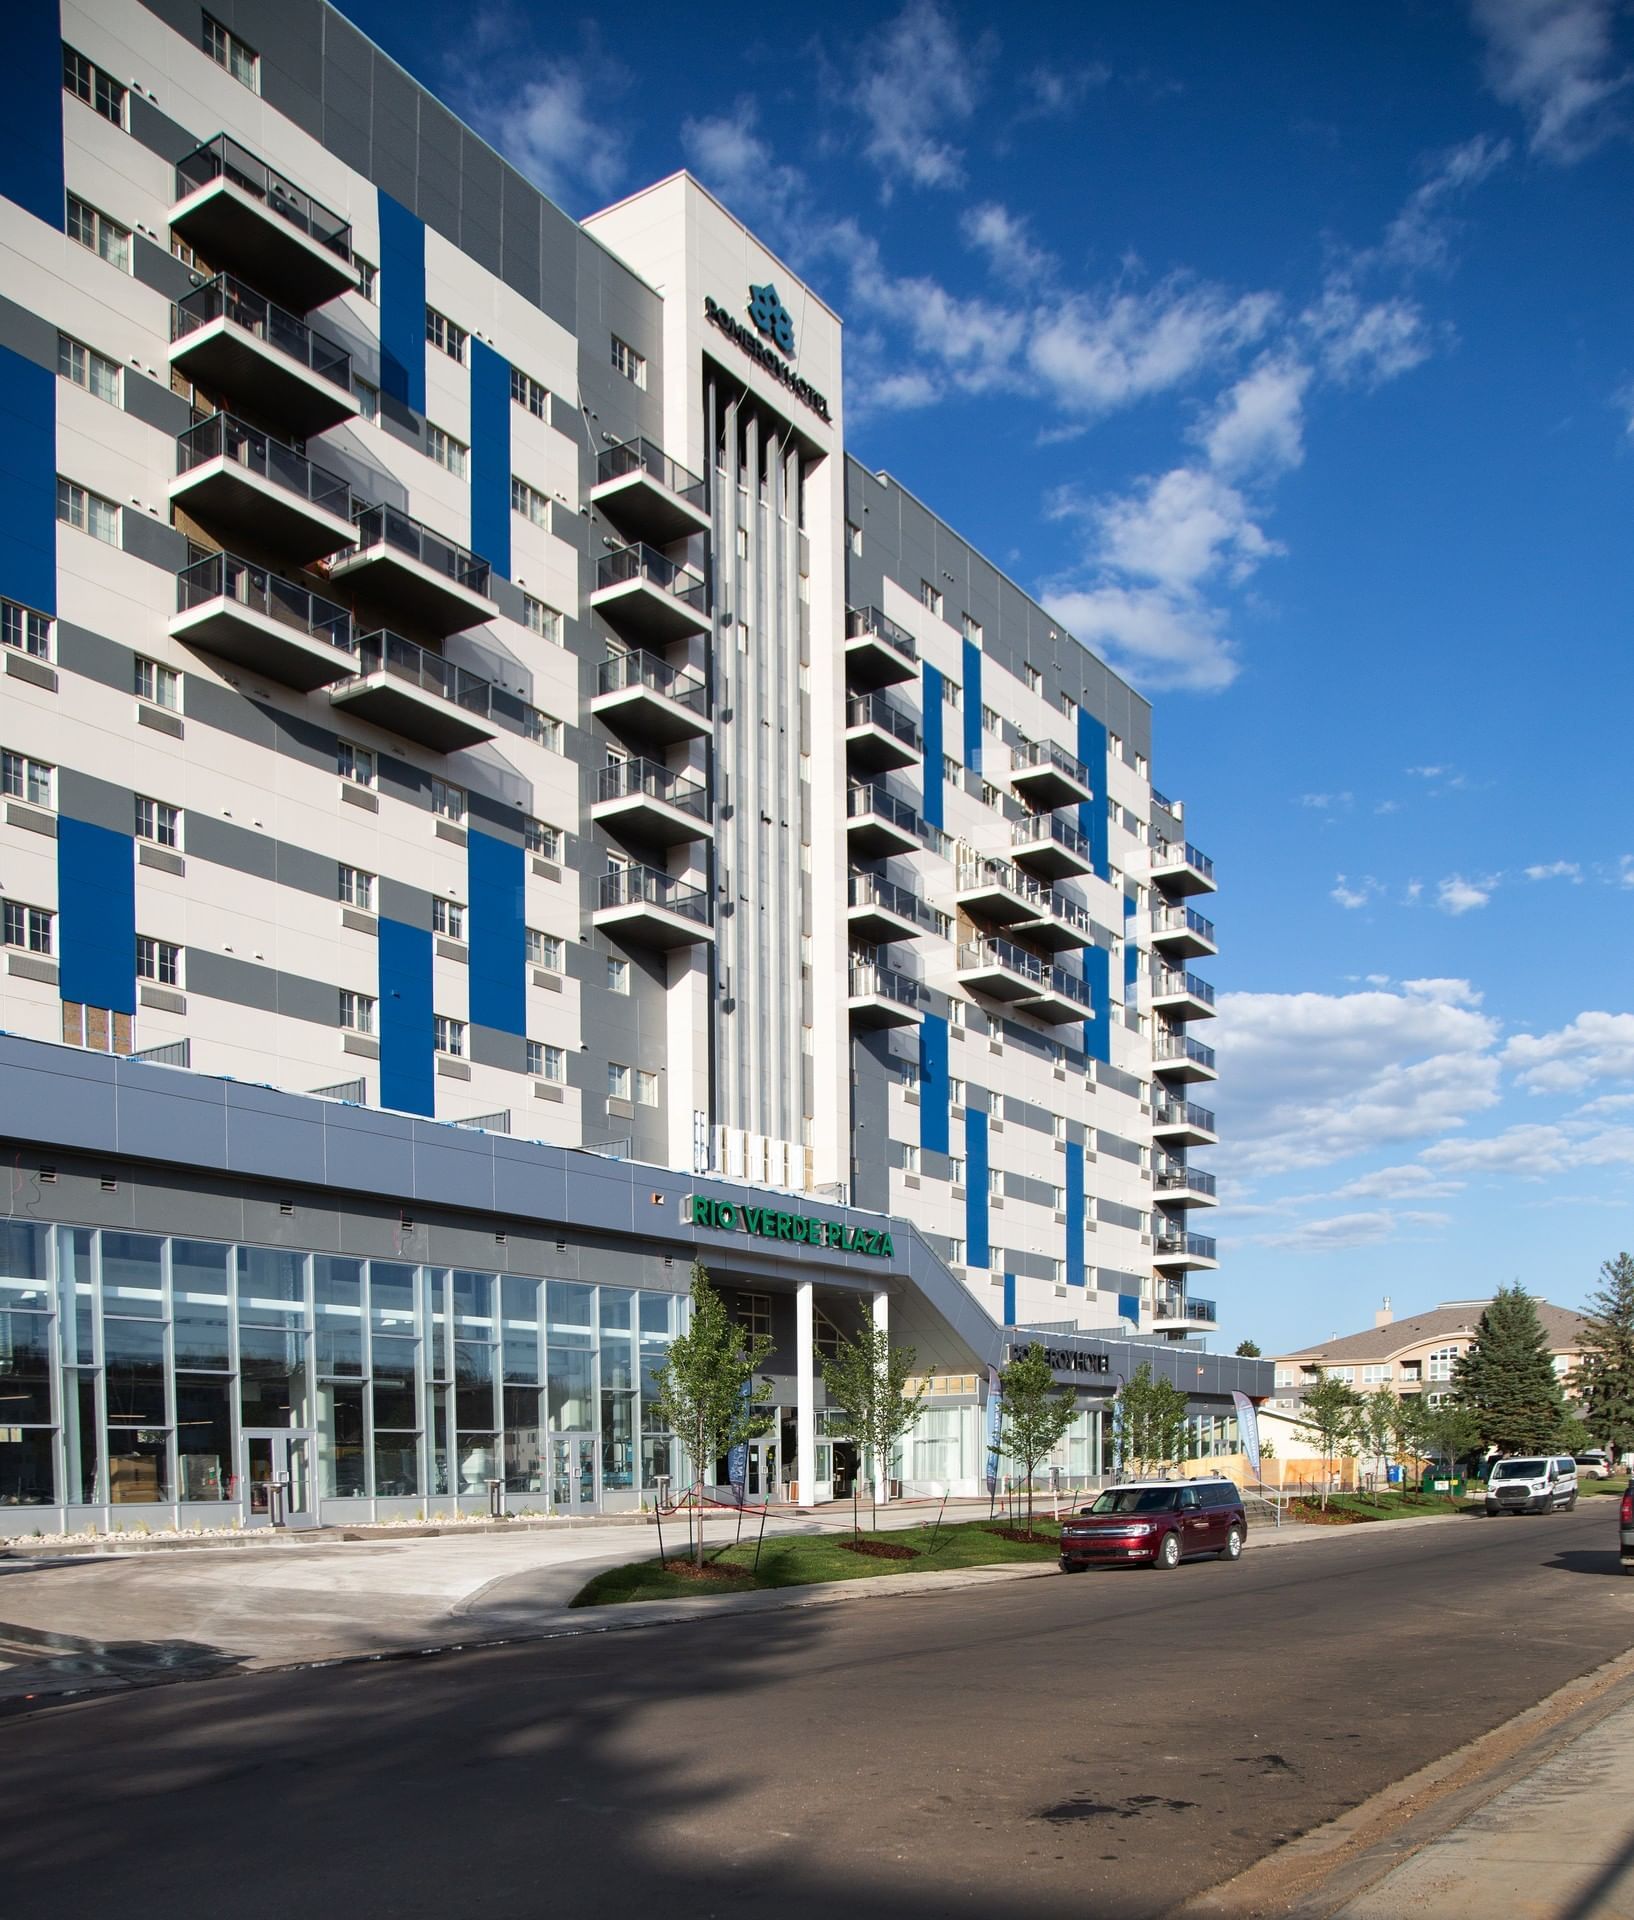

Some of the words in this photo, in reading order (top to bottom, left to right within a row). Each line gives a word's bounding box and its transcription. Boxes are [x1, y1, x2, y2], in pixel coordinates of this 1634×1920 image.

[704, 296, 787, 383] POMEROY
[784, 366, 833, 422] HOTEL
[691, 1194, 738, 1230] RIO
[741, 1205, 823, 1246] VERDE
[827, 1222, 895, 1257] PLAZA
[1008, 1343, 1076, 1370] POEROY
[1074, 1351, 1110, 1374] HOTEL
